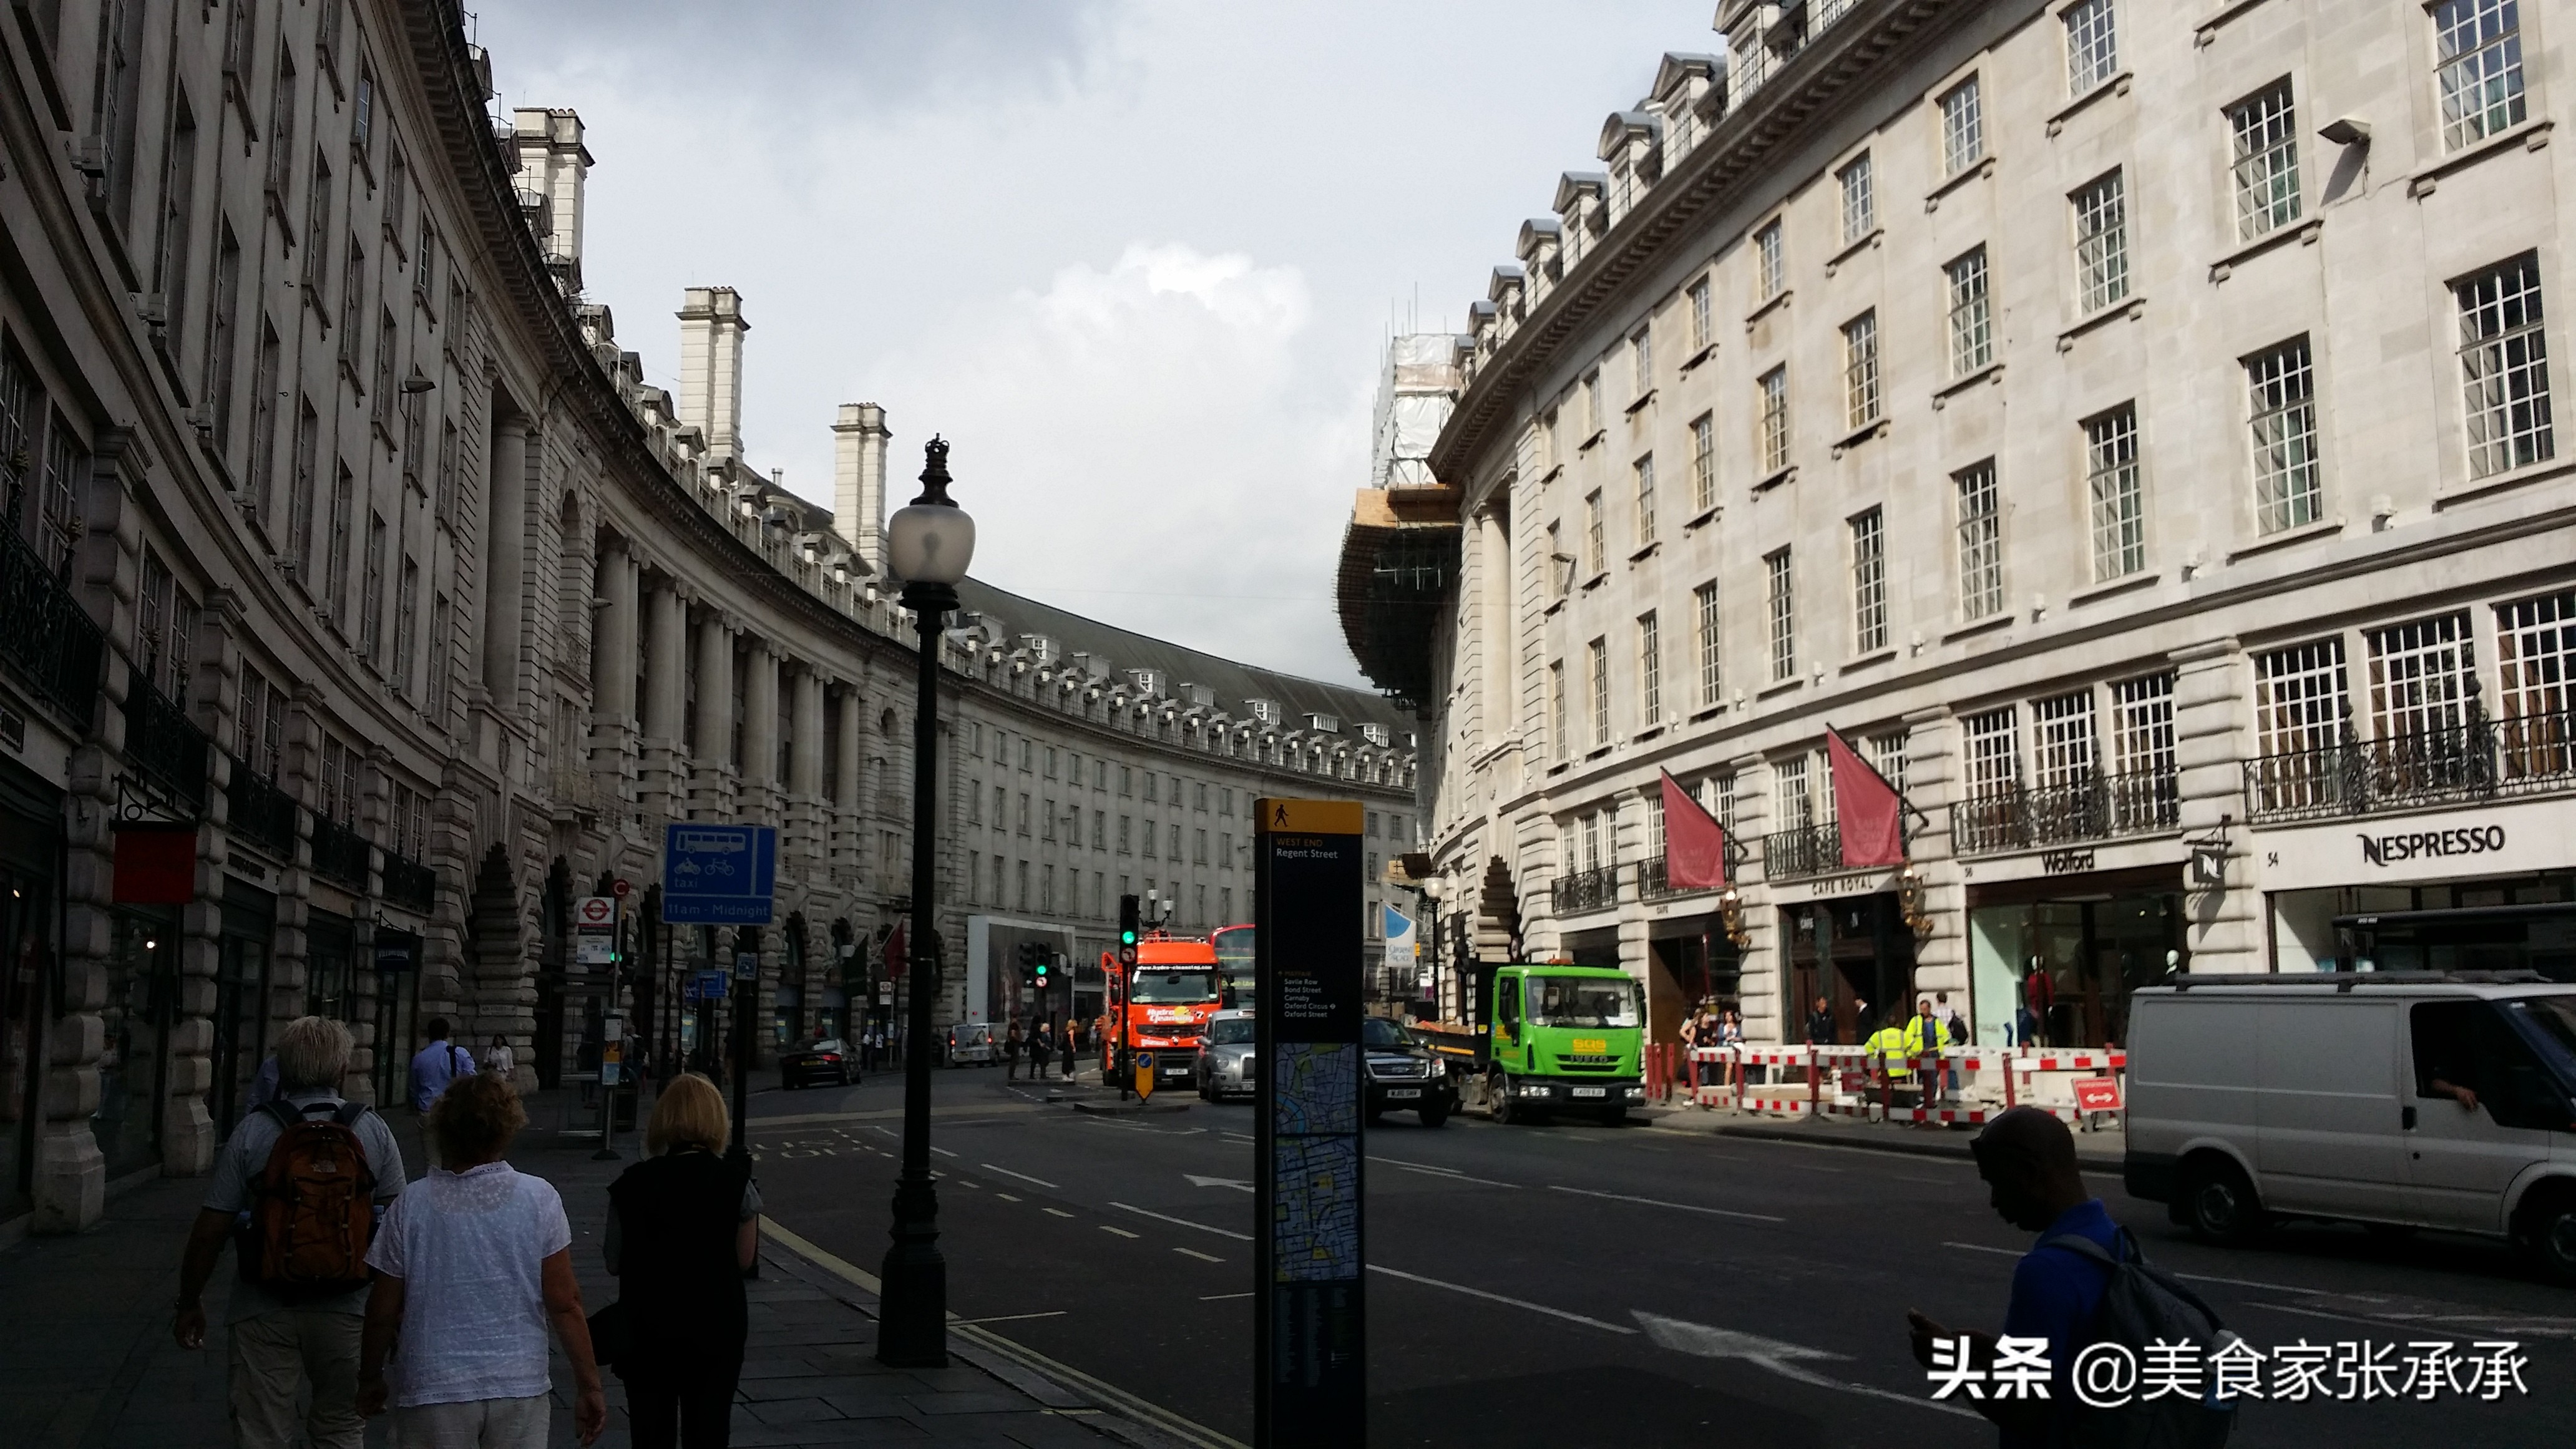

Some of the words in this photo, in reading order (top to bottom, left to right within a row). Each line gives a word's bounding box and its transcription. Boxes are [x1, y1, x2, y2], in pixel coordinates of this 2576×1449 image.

[1276, 837, 1300, 846] WEST
[1304, 838, 1323, 847] END
[2356, 826, 2505, 866] NESPRESSO
[1276, 847, 1308, 859] Regent
[1310, 849, 1339, 859] Street
[2268, 852, 2279, 867] 54
[2041, 849, 2095, 874] Wolford
[674, 877, 698, 888] taxi
[1812, 881, 1835, 895] CAFE
[1841, 876, 1873, 891] ROYAL
[668, 904, 700, 915] 11am
[712, 904, 768, 918] Midnight
[1147, 1008, 1174, 1017] Hydro
